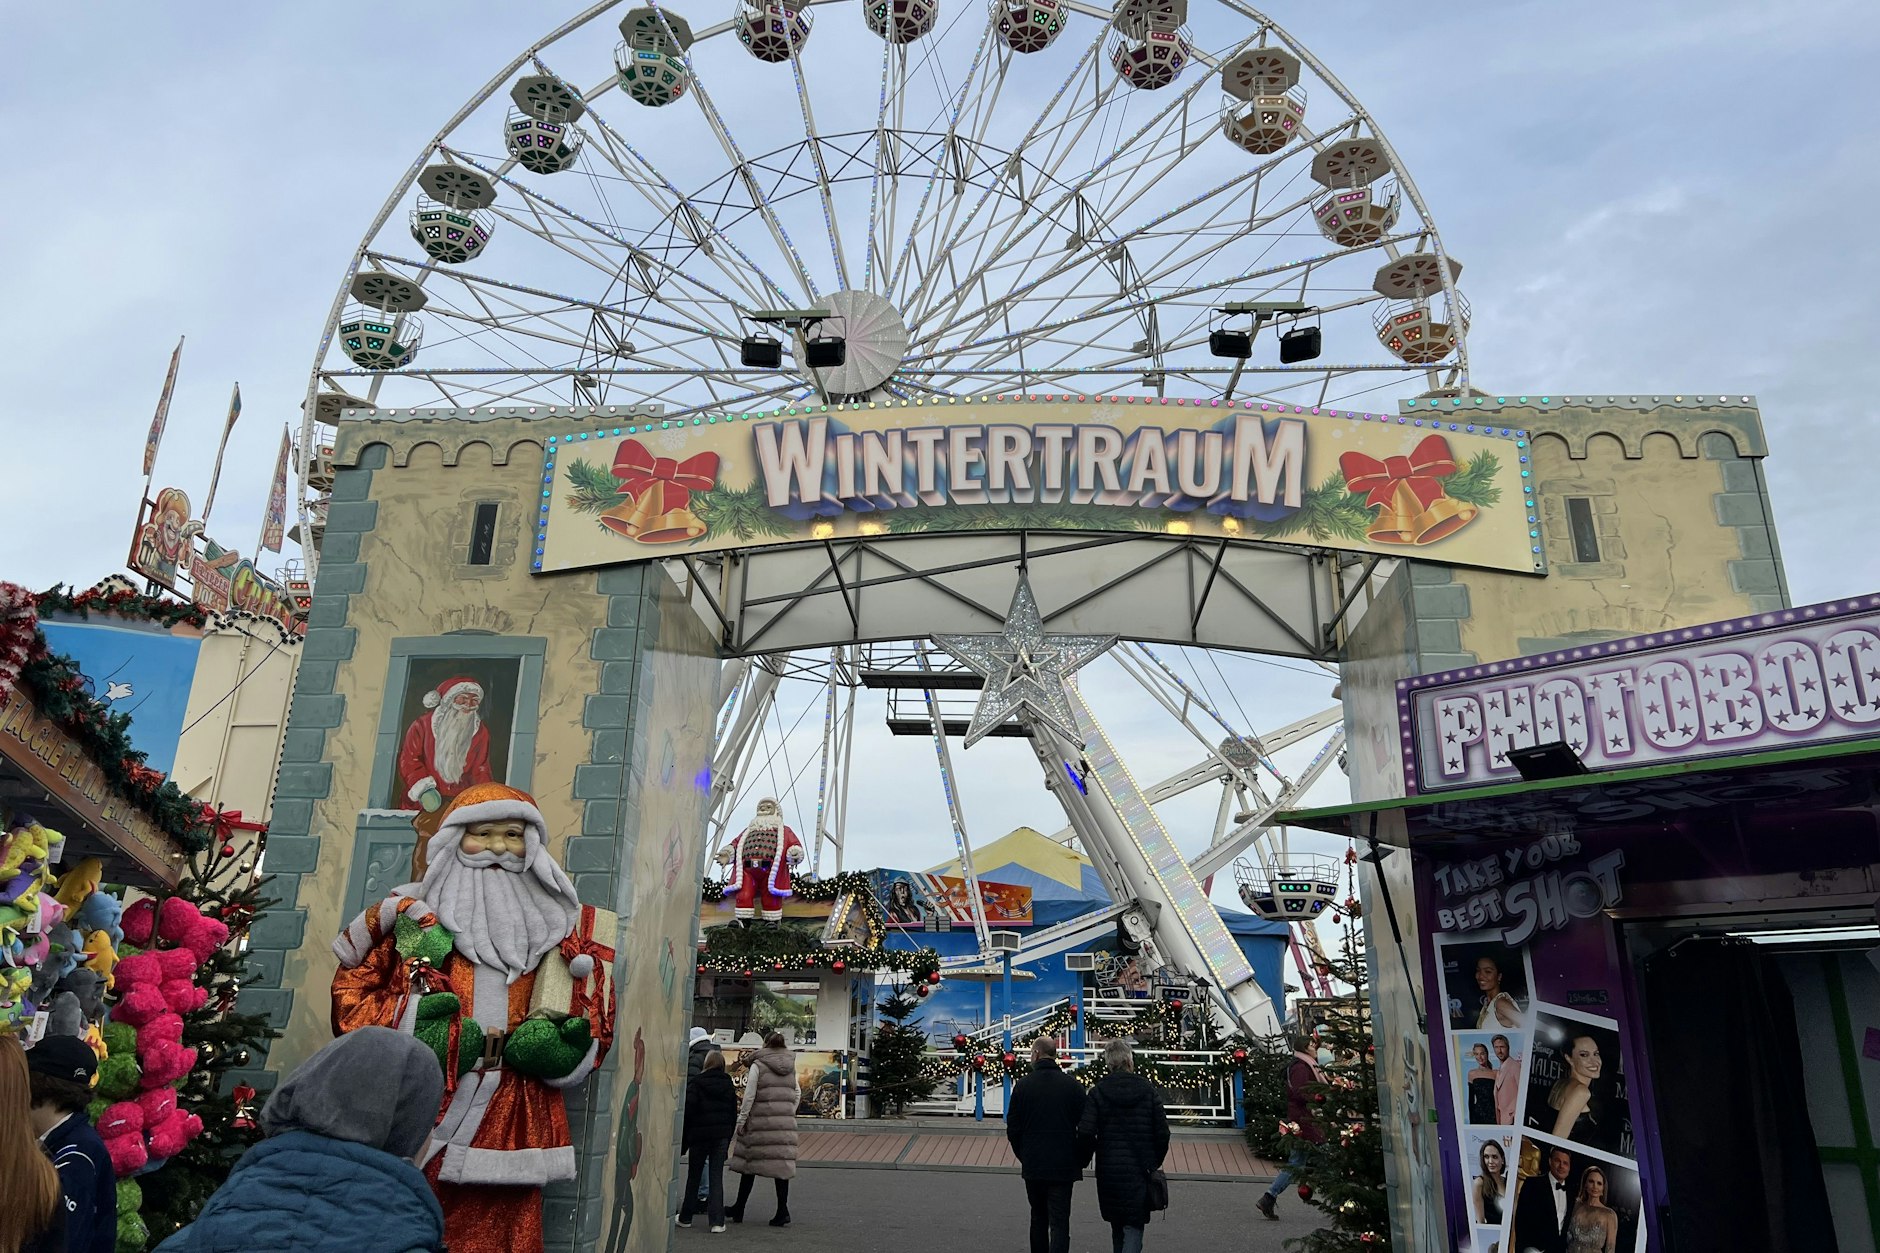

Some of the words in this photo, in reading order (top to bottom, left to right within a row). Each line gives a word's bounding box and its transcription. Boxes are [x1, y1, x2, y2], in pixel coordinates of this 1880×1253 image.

[753, 413, 1306, 512] WINTERTRAUM
[1434, 854, 1502, 897] TAKE
[1505, 834, 1581, 875] YOUR
[1437, 889, 1502, 931] BEST
[1503, 850, 1625, 946] SHOT
